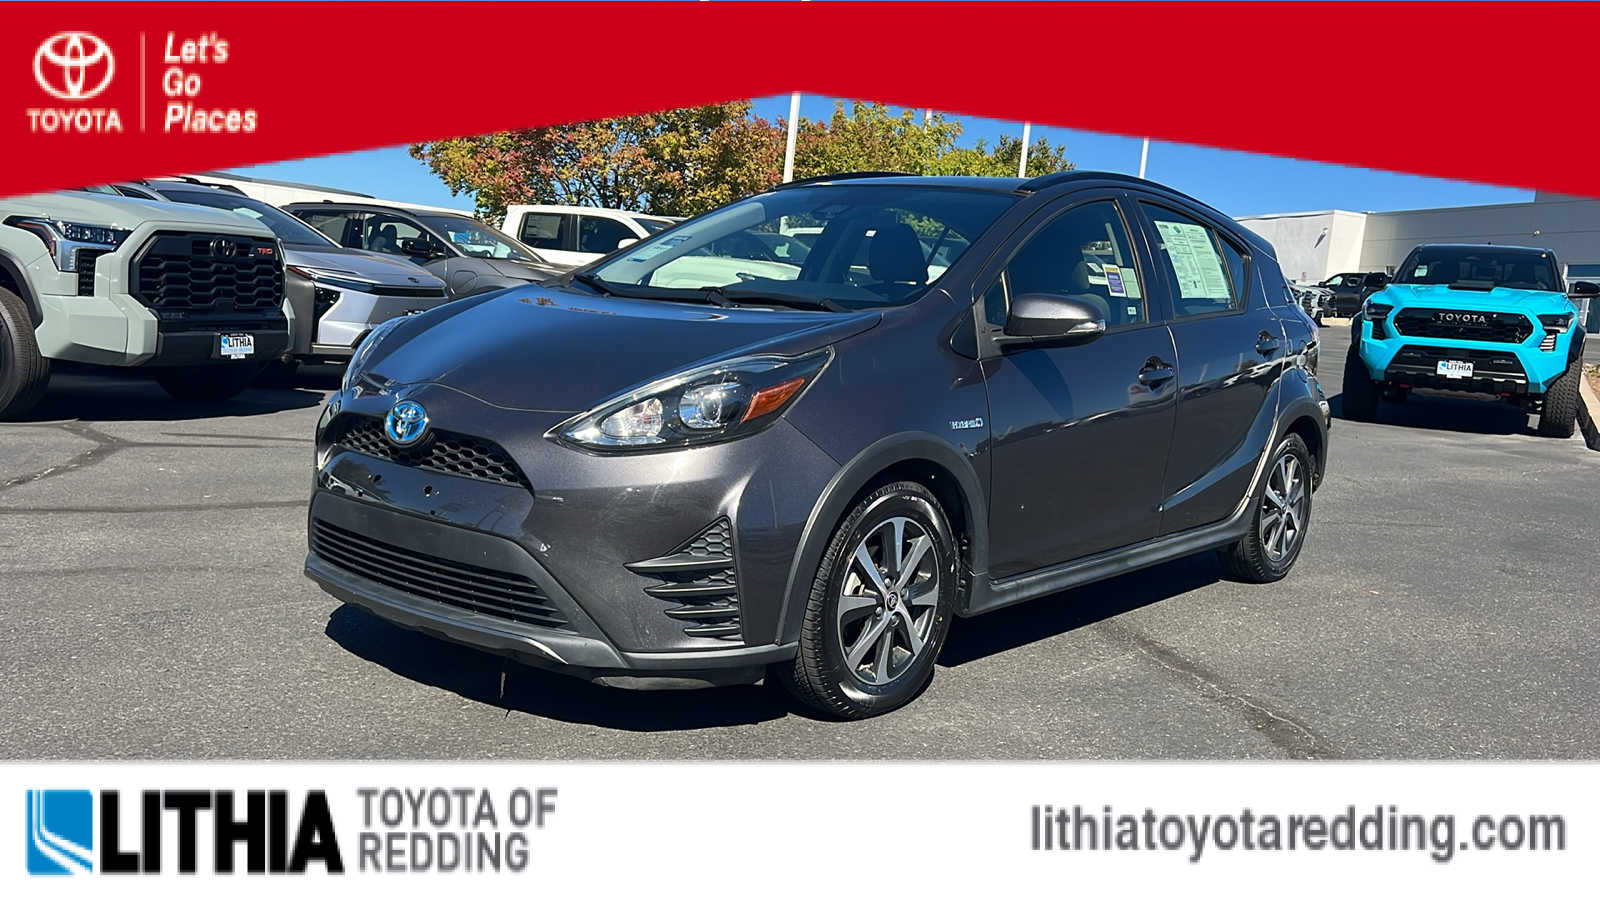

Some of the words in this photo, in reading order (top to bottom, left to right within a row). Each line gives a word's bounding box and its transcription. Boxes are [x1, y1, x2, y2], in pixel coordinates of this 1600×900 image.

[1438, 313, 1486, 323] TOYOTA
[228, 337, 252, 347] LITHIA
[1446, 363, 1471, 371] LITHIA
